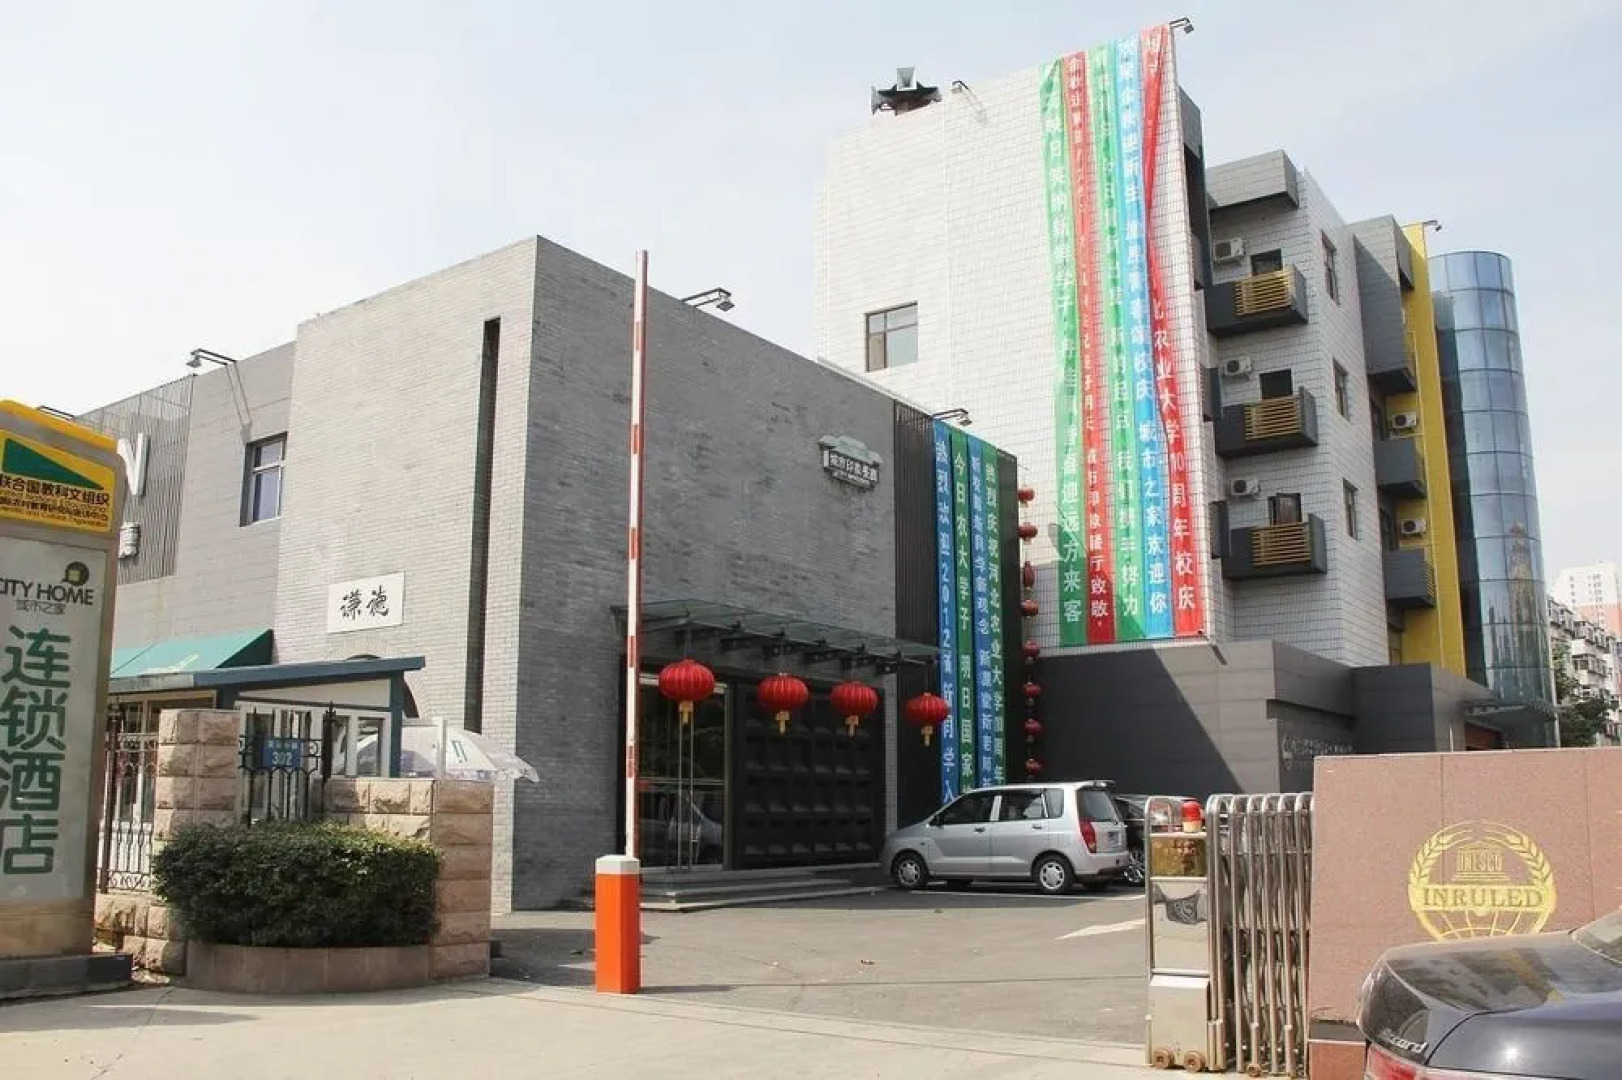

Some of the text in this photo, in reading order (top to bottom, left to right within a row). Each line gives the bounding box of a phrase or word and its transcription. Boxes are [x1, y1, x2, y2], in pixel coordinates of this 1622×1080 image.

[37, 583, 94, 606] HOME
[0, 625, 71, 874] 连锁酒店
[1422, 887, 1544, 908] INRULED
